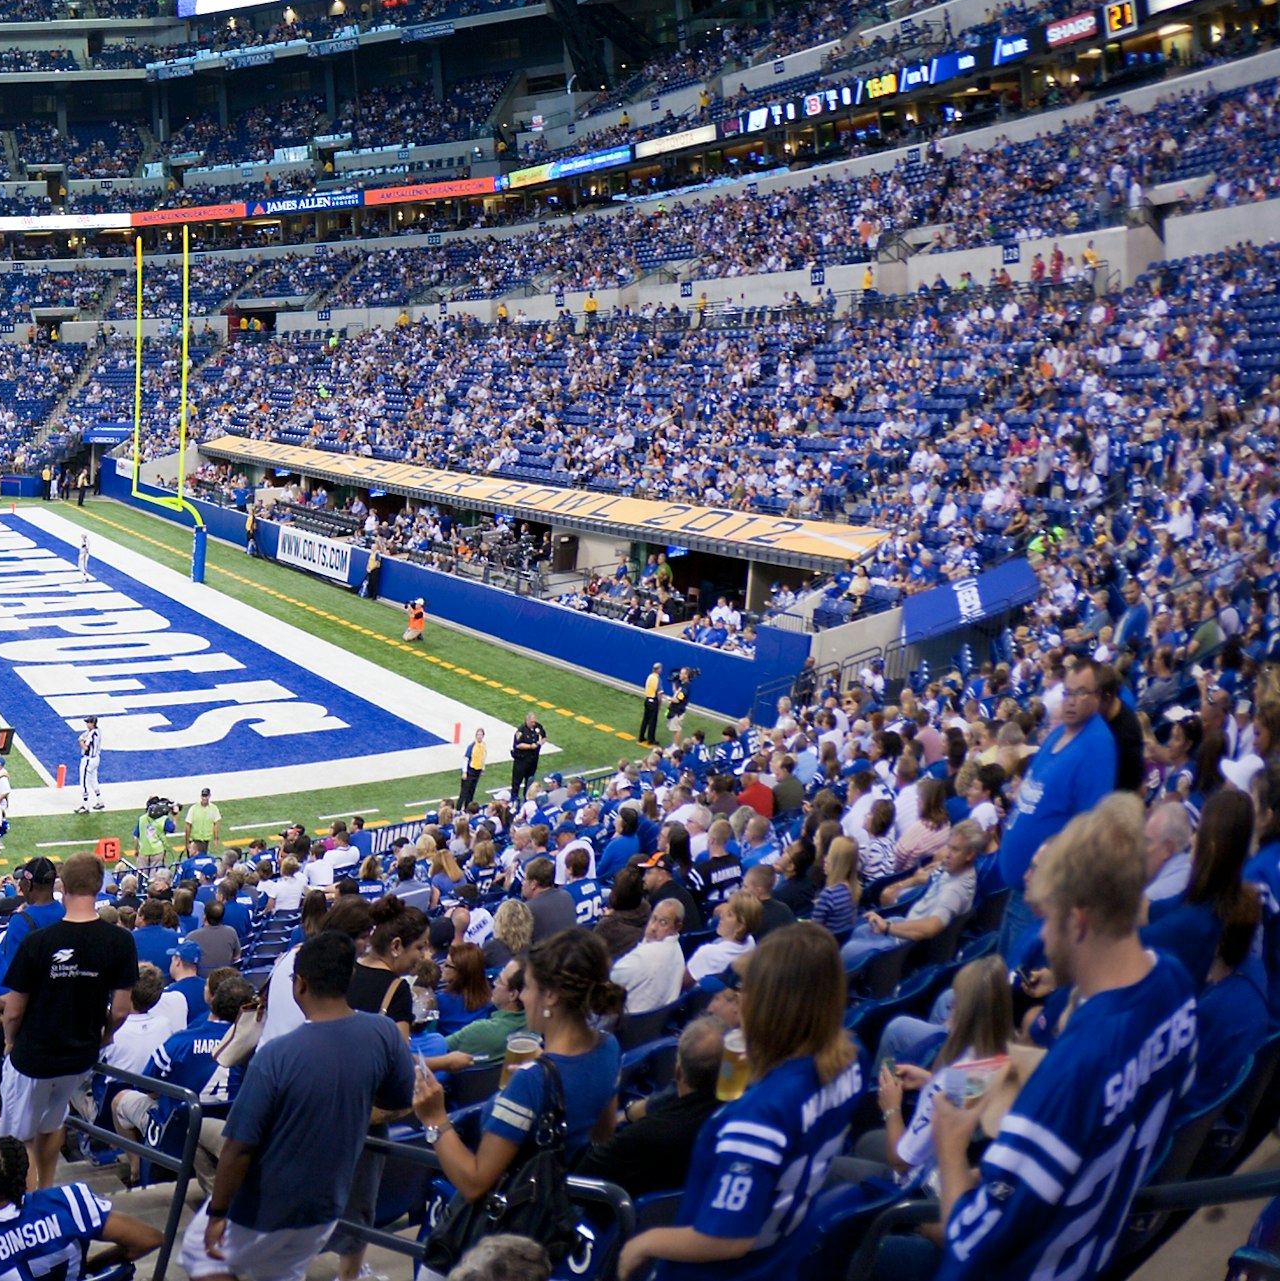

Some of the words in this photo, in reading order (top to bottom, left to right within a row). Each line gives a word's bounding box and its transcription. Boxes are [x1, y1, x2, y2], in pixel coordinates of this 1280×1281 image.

[1046, 16, 1096, 40] SHARP
[1108, 4, 1132, 32] 21
[266, 200, 298, 214] JAMES
[299, 198, 331, 211] ALLEN
[811, 272, 825, 282] 127
[352, 464, 481, 494] SUPER
[487, 485, 621, 518] BOWL
[643, 505, 804, 545] 2012
[280, 529, 348, 574] WWW.COLTS.COM
[104, 842, 116, 859] G
[711, 866, 742, 884] MANNING
[576, 899, 602, 926] 29
[711, 1173, 754, 1212] 18
